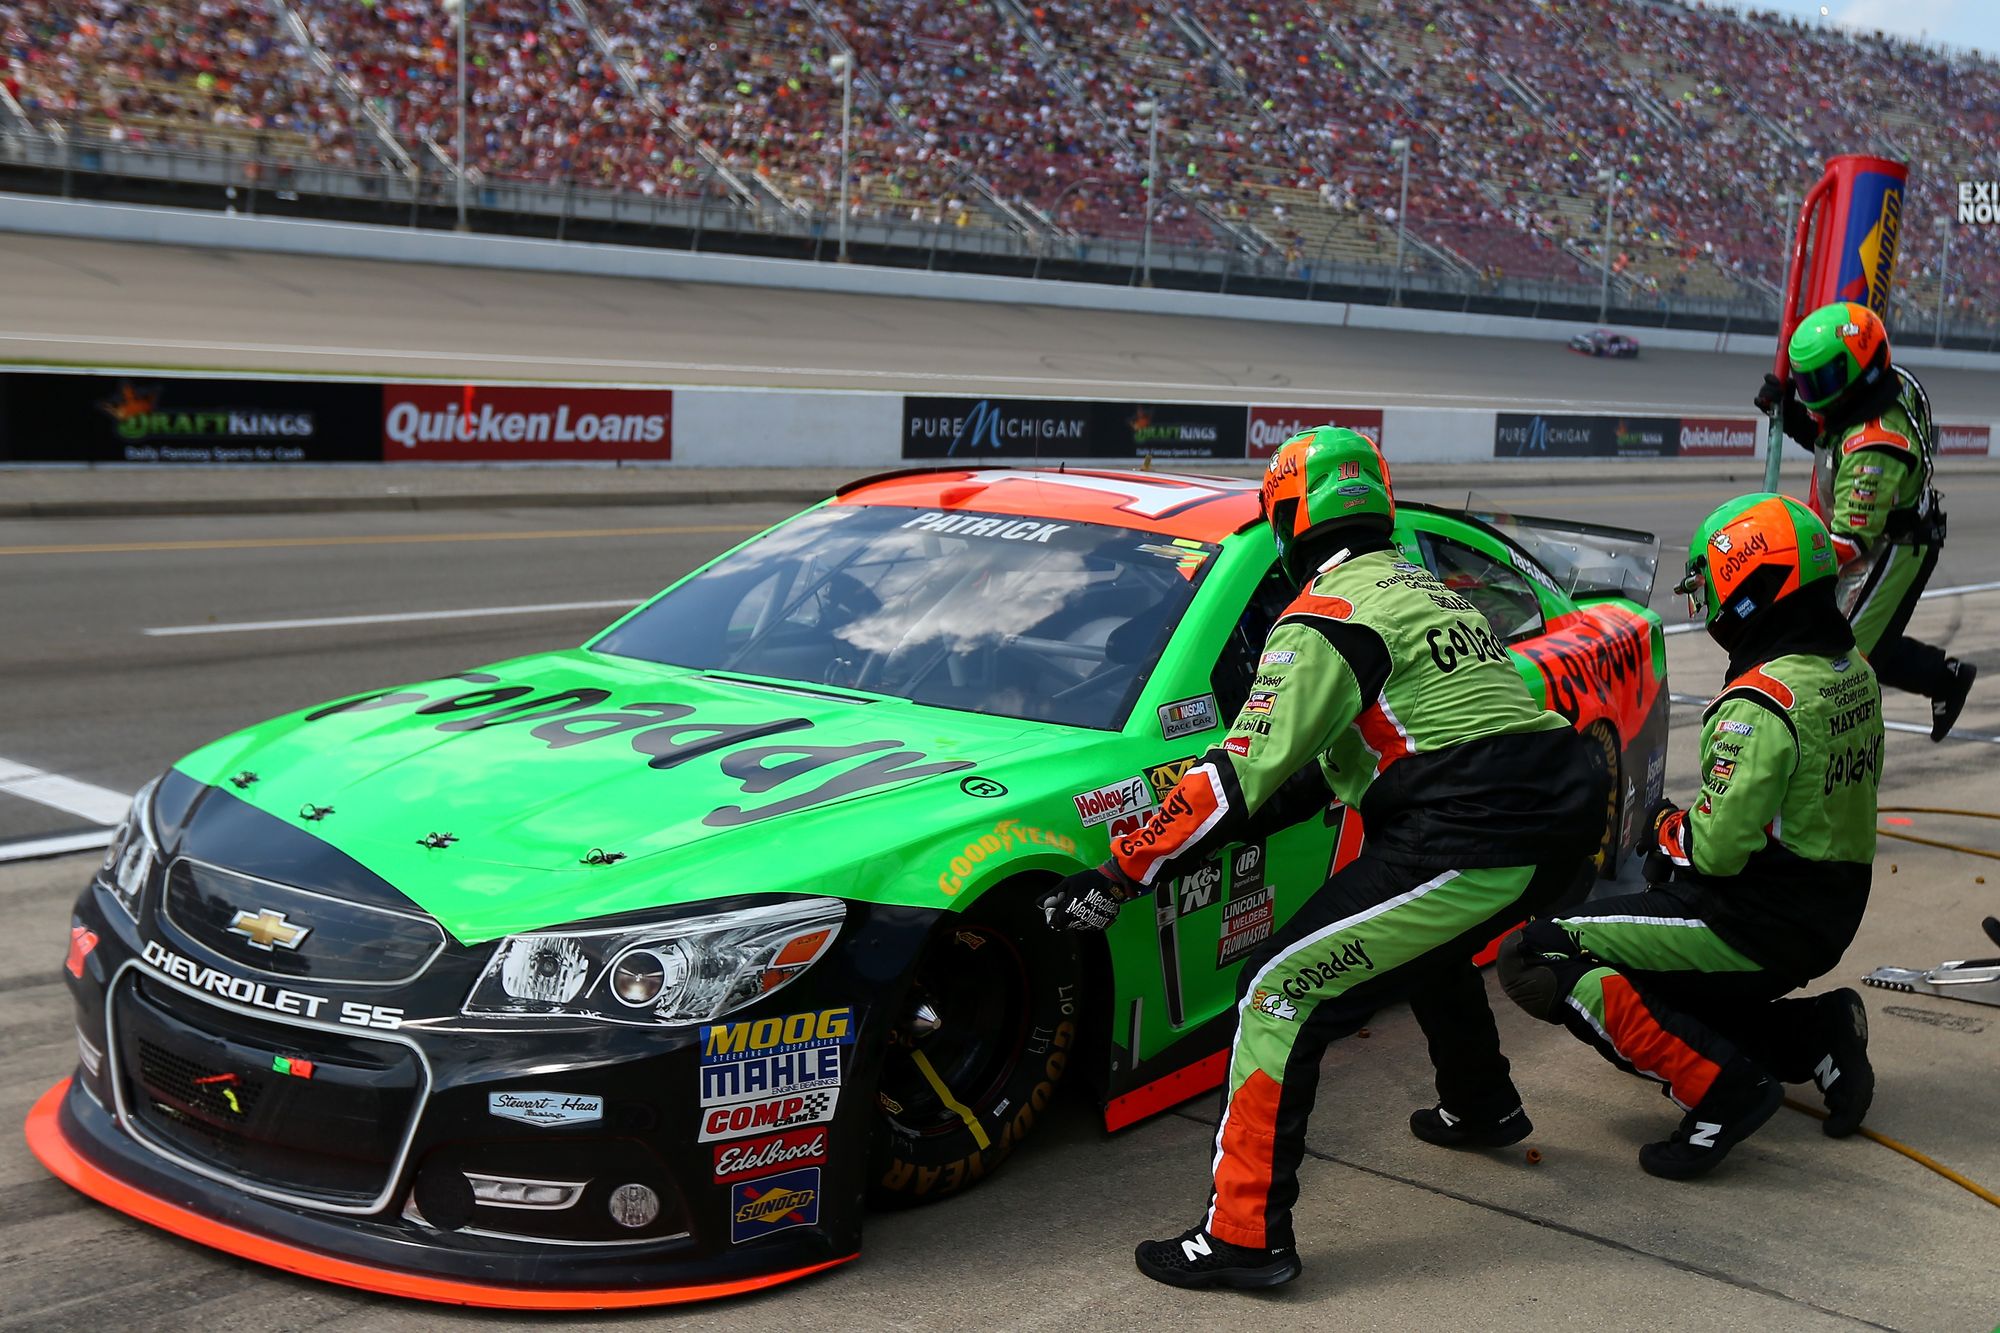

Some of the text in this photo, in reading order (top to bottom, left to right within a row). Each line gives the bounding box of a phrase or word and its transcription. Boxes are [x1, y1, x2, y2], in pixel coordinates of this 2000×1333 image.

[1870, 193, 1900, 316] SUNOCO
[117, 411, 314, 438] DRAFTKINGS
[386, 402, 665, 448] Quicken Loans
[911, 400, 1082, 456] PURE MICHIGAN
[1499, 427, 1527, 442] PURE
[1680, 426, 1724, 448] Quicken
[1723, 427, 1755, 447] Loans
[1337, 461, 1360, 481] 10
[901, 511, 1070, 543] PATRICK
[1720, 531, 1769, 582] GoDaddy
[1265, 652, 1292, 664] NASCAR
[1167, 716, 1213, 733] RACE CAR
[1180, 701, 1206, 719] NASCAR
[1223, 741, 1247, 754] Hanes
[1074, 789, 1124, 819] Holley
[1121, 779, 1144, 808] EFI
[1120, 788, 1194, 857] GoDaddy
[1224, 890, 1266, 920] LINCOLN
[1232, 906, 1268, 930] WELDERS
[1220, 921, 1272, 965] FLOWMASTER
[1282, 938, 1375, 1000] GoDaddy
[141, 940, 405, 1030] CHEVROLET SS
[705, 1007, 850, 1057] MOOG
[713, 1049, 762, 1063] STEERING
[780, 1037, 840, 1052] SUSPENSION
[702, 1046, 839, 1099] MAHLE
[772, 1077, 839, 1095] ENGINE BEARINGS
[493, 1095, 599, 1112] Stewart Haas
[706, 1097, 804, 1135] COMP
[772, 1111, 820, 1127] CAMS
[715, 1133, 824, 1175] Edelbrock
[739, 1191, 812, 1220] SUNOCO
[1181, 1233, 1213, 1262] N
